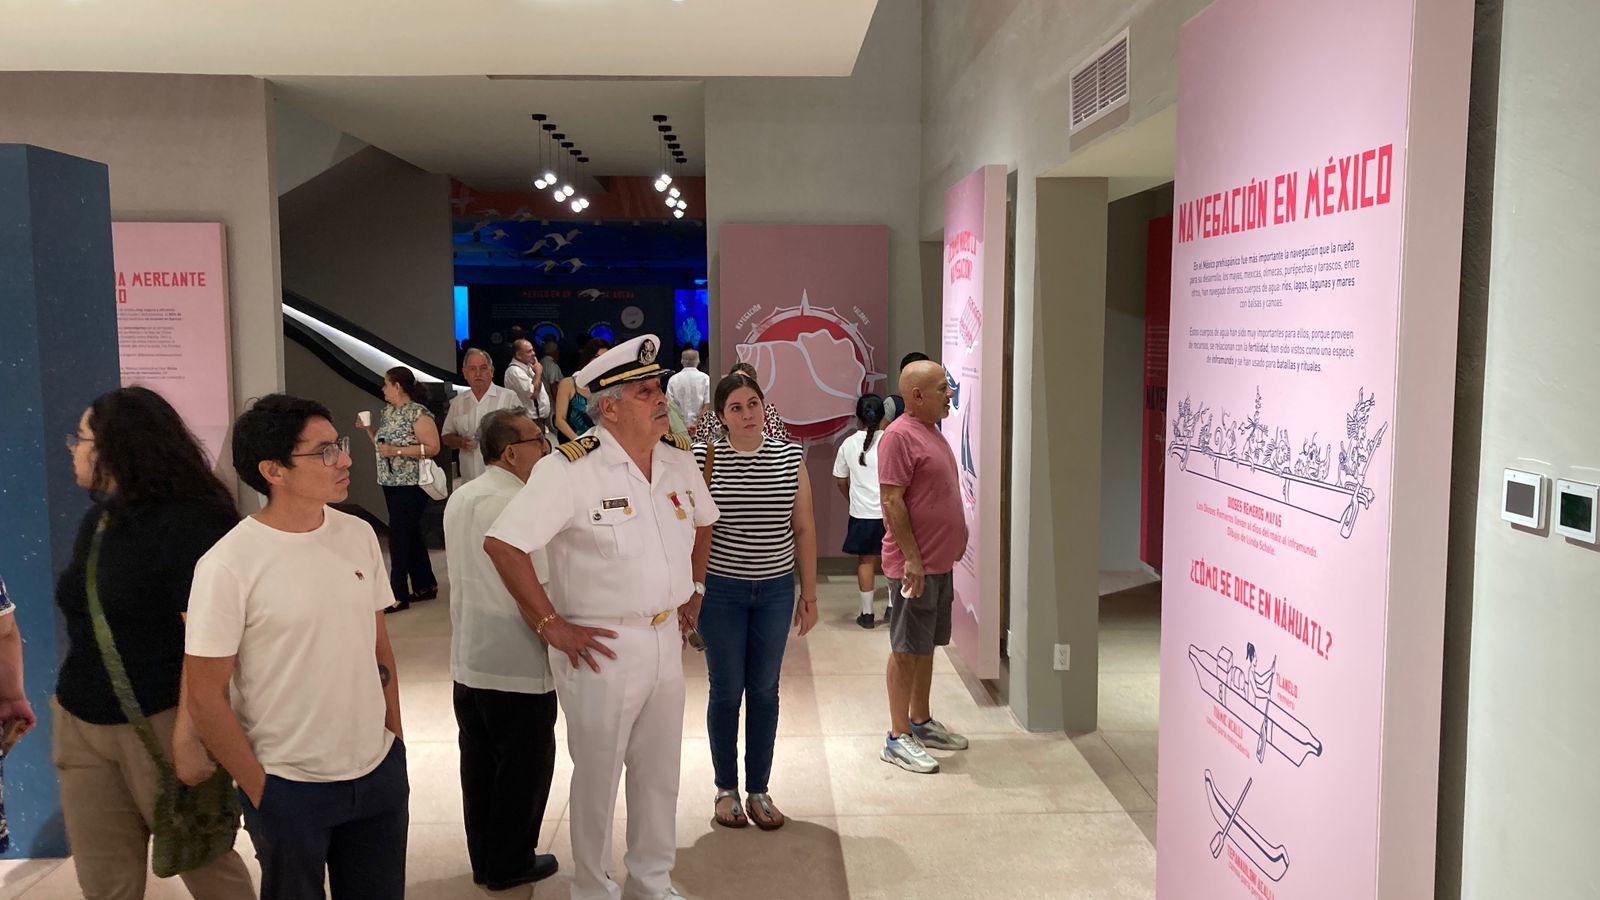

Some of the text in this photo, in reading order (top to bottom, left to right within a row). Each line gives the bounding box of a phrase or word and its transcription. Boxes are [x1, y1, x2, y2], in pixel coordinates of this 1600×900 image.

[1178, 143, 1393, 244] NAVEGACIÓN EN MÉXICO
[1216, 256, 1240, 271] prehispánico
[1249, 253, 1258, 263] más
[1259, 250, 1283, 263] importante
[1284, 249, 1289, 259] la
[1290, 244, 1318, 260] navegación
[1319, 246, 1330, 257] que
[1331, 242, 1337, 253] la
[1337, 241, 1354, 252] rueda
[132, 272, 206, 286] MERCANTE
[1244, 269, 1262, 279] mexicas,
[1263, 267, 1283, 278] olmecas,
[1284, 263, 1313, 278] purépechas
[1318, 261, 1343, 272] tarascos,
[1344, 258, 1360, 269] entre
[1209, 286, 1226, 298] navegado
[1227, 285, 1243, 295] diversos
[1244, 284, 1261, 296] cuerpos
[1262, 282, 1267, 292] de
[1269, 283, 1281, 295] agua:
[1282, 280, 1293, 291] ríos,
[1294, 279, 1309, 292] lagos,
[1310, 279, 1331, 292] lagunas
[1337, 276, 1355, 287] mares
[1248, 298, 1261, 308] balsas
[1200, 328, 1213, 339] cuerpos
[1220, 328, 1229, 339] agua
[1238, 328, 1246, 337] sido
[1247, 328, 1256, 339] muy
[1257, 328, 1284, 340] importantes
[1285, 330, 1296, 341] para
[1297, 328, 1310, 340] ellos,
[1312, 330, 1330, 341] porque
[1331, 330, 1354, 342] proveen
[1215, 342, 1235, 351] relacionan
[1248, 342, 1269, 353] fertilidad,
[1271, 343, 1279, 353] han
[1280, 344, 1290, 354] sido
[1291, 344, 1304, 355] vistos
[1306, 346, 1320, 356] como
[1321, 347, 1331, 356] una
[1333, 345, 1354, 359] especie
[1212, 354, 1233, 365] inframundo
[1243, 357, 1251, 366] han
[1252, 358, 1264, 368] usado
[1266, 360, 1276, 370] para
[1277, 359, 1296, 371] batallas
[1301, 360, 1322, 373] rituales.
[1227, 496, 1282, 527] DIOSES REMEROS MAYAS
[1203, 503, 1216, 516] Dioses
[1216, 508, 1234, 524] Remeros
[1252, 521, 1262, 535] dios
[1287, 535, 1318, 558] inframundo.
[1226, 526, 1240, 541] Dibujo
[1241, 531, 1246, 543] de
[1247, 535, 1259, 549] Linda
[1190, 557, 1333, 660] ¿CÓMO SE DICE EN NÁHUATL?
